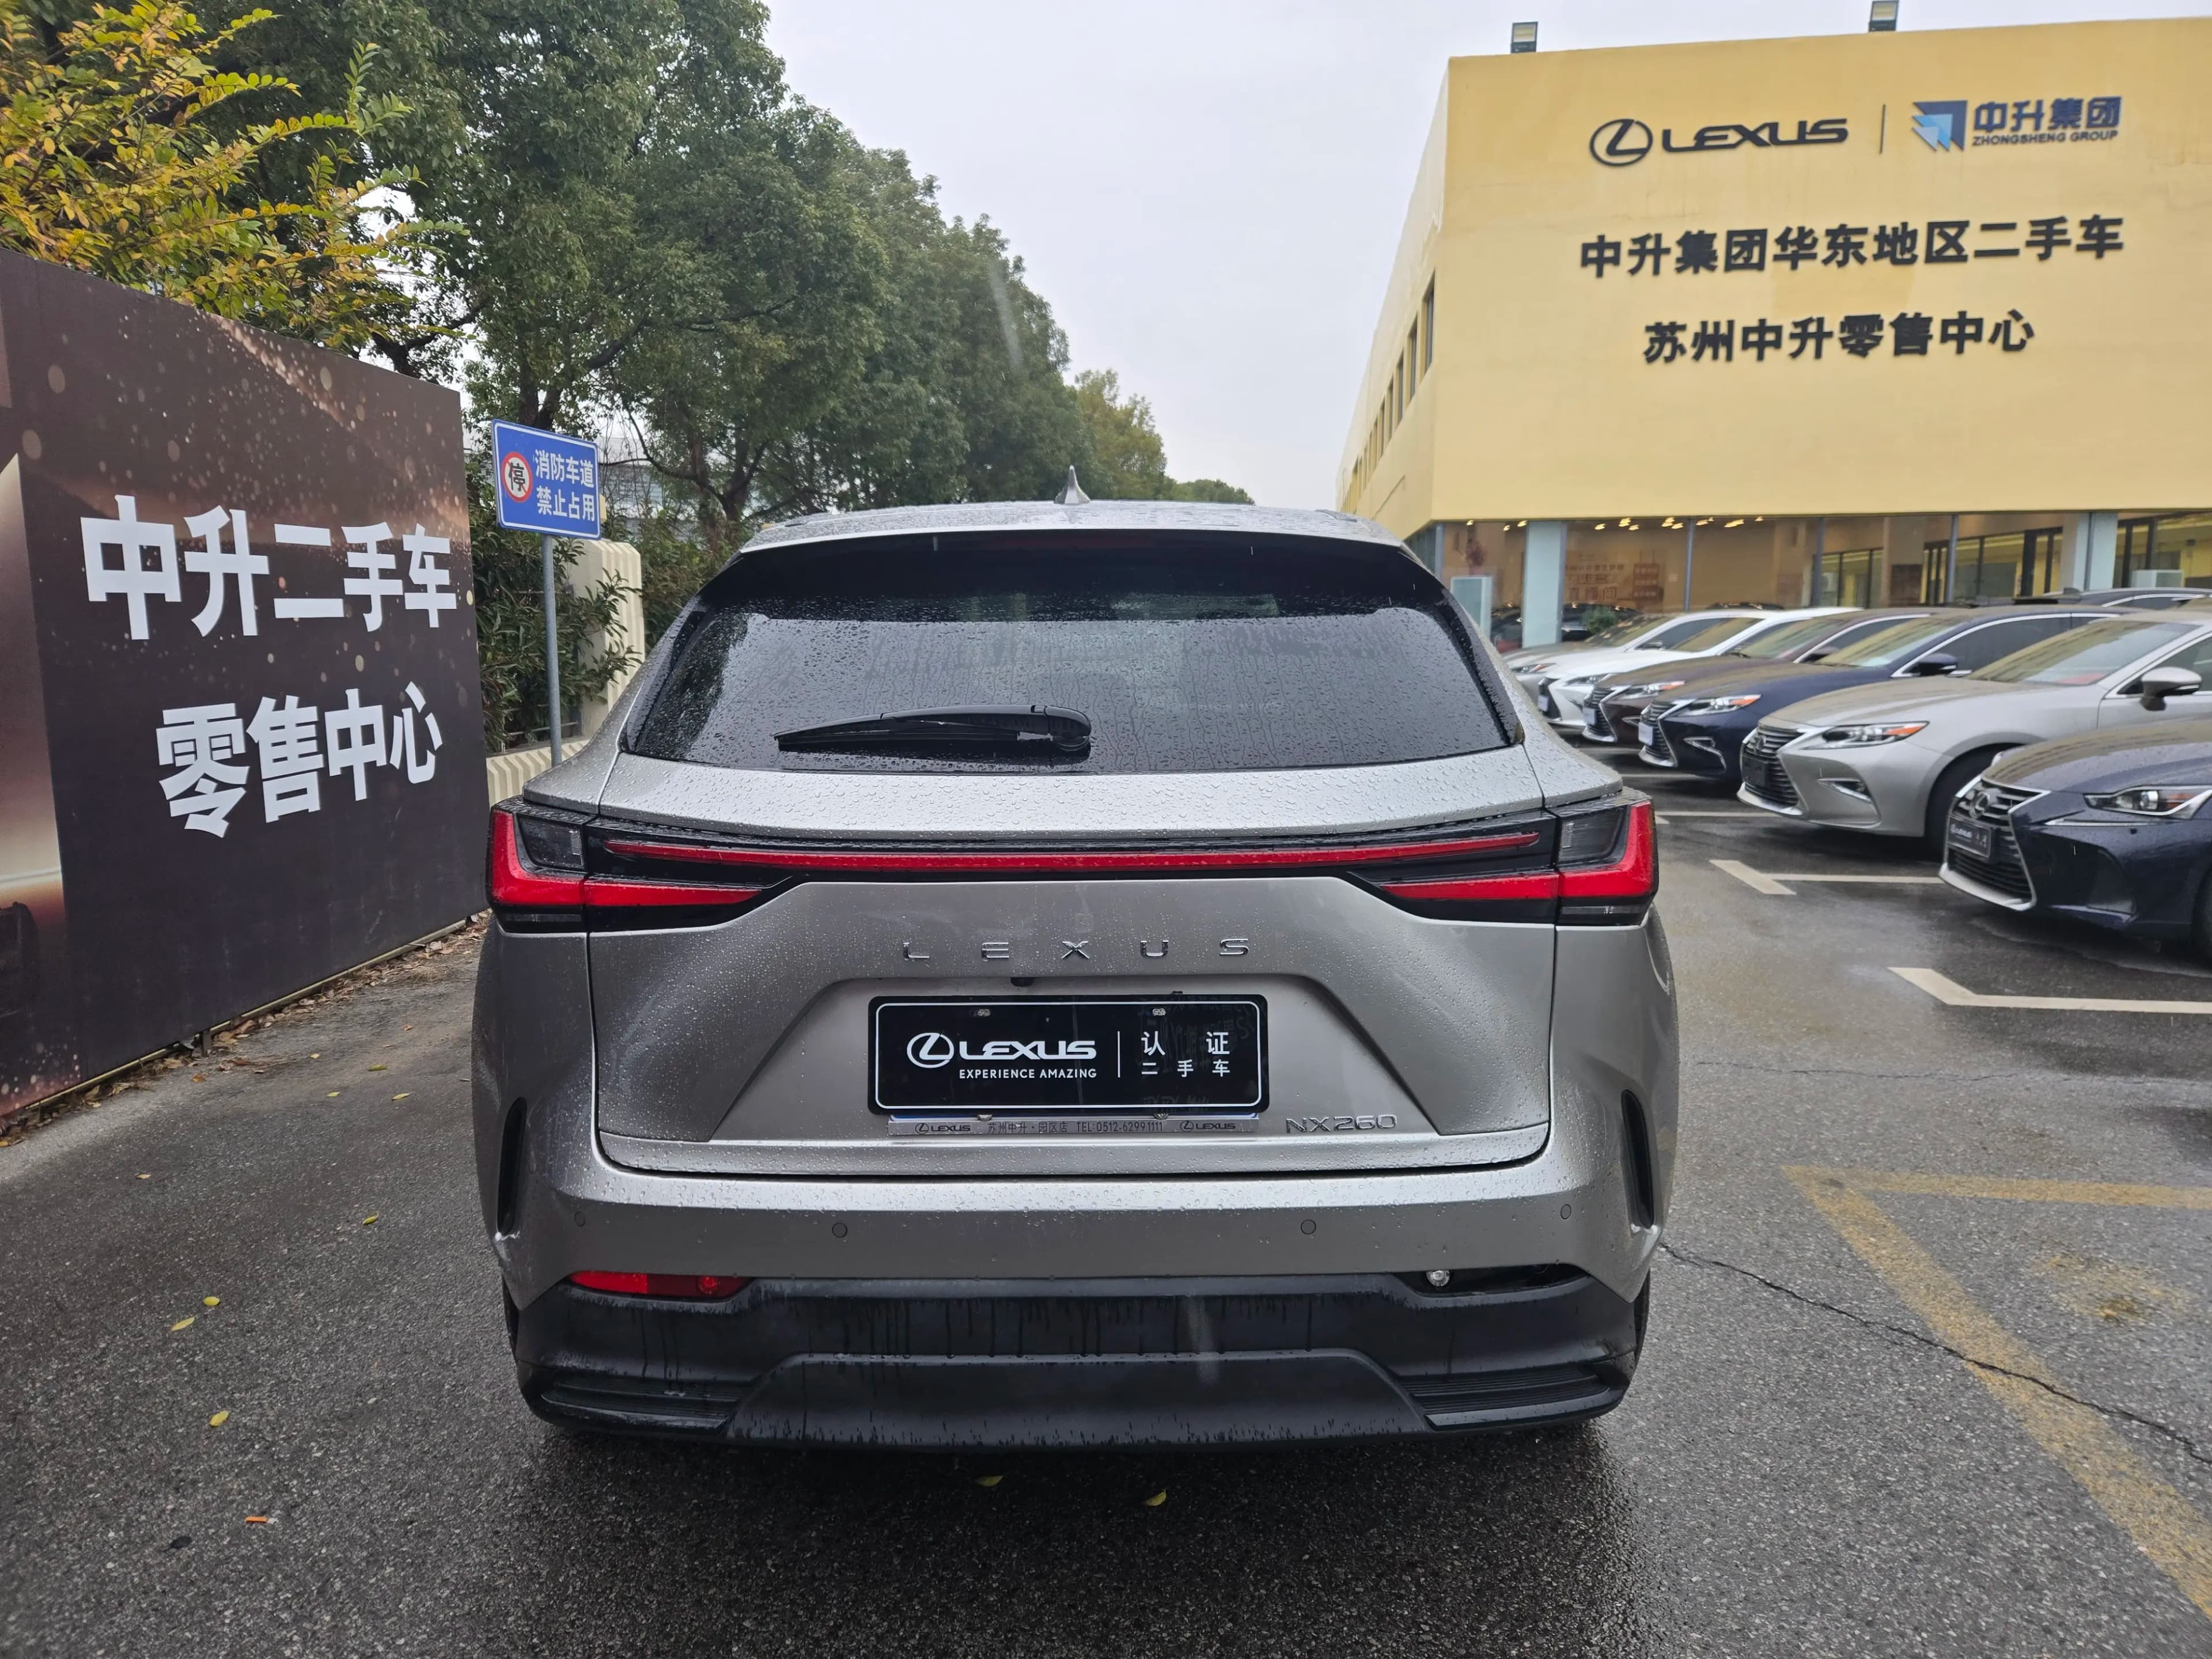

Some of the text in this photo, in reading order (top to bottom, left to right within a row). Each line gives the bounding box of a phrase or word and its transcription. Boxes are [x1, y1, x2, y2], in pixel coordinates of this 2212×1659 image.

[1973, 96, 2122, 132] 中升集团
[1662, 119, 1848, 153] LEXUS
[1972, 128, 2119, 146] ZHONGSHENG GROUP
[1580, 214, 2124, 278] 中升集团华东地区二手车
[1643, 309, 2035, 363] 苏州中升零售中心
[508, 462, 525, 491] 停
[535, 449, 594, 488] 消防车道
[536, 485, 595, 522] 禁止占用
[80, 494, 457, 641] 中升二手车
[156, 681, 442, 839] 零售中心
[902, 937, 1250, 961] LEXUS
[959, 1040, 1097, 1060] LEXUS
[1141, 1030, 1230, 1056] 认证
[959, 1068, 1097, 1080] EXPERIENCE AMAZING
[1141, 1059, 1230, 1078] 二手车
[1286, 1113, 1398, 1134] NX260
